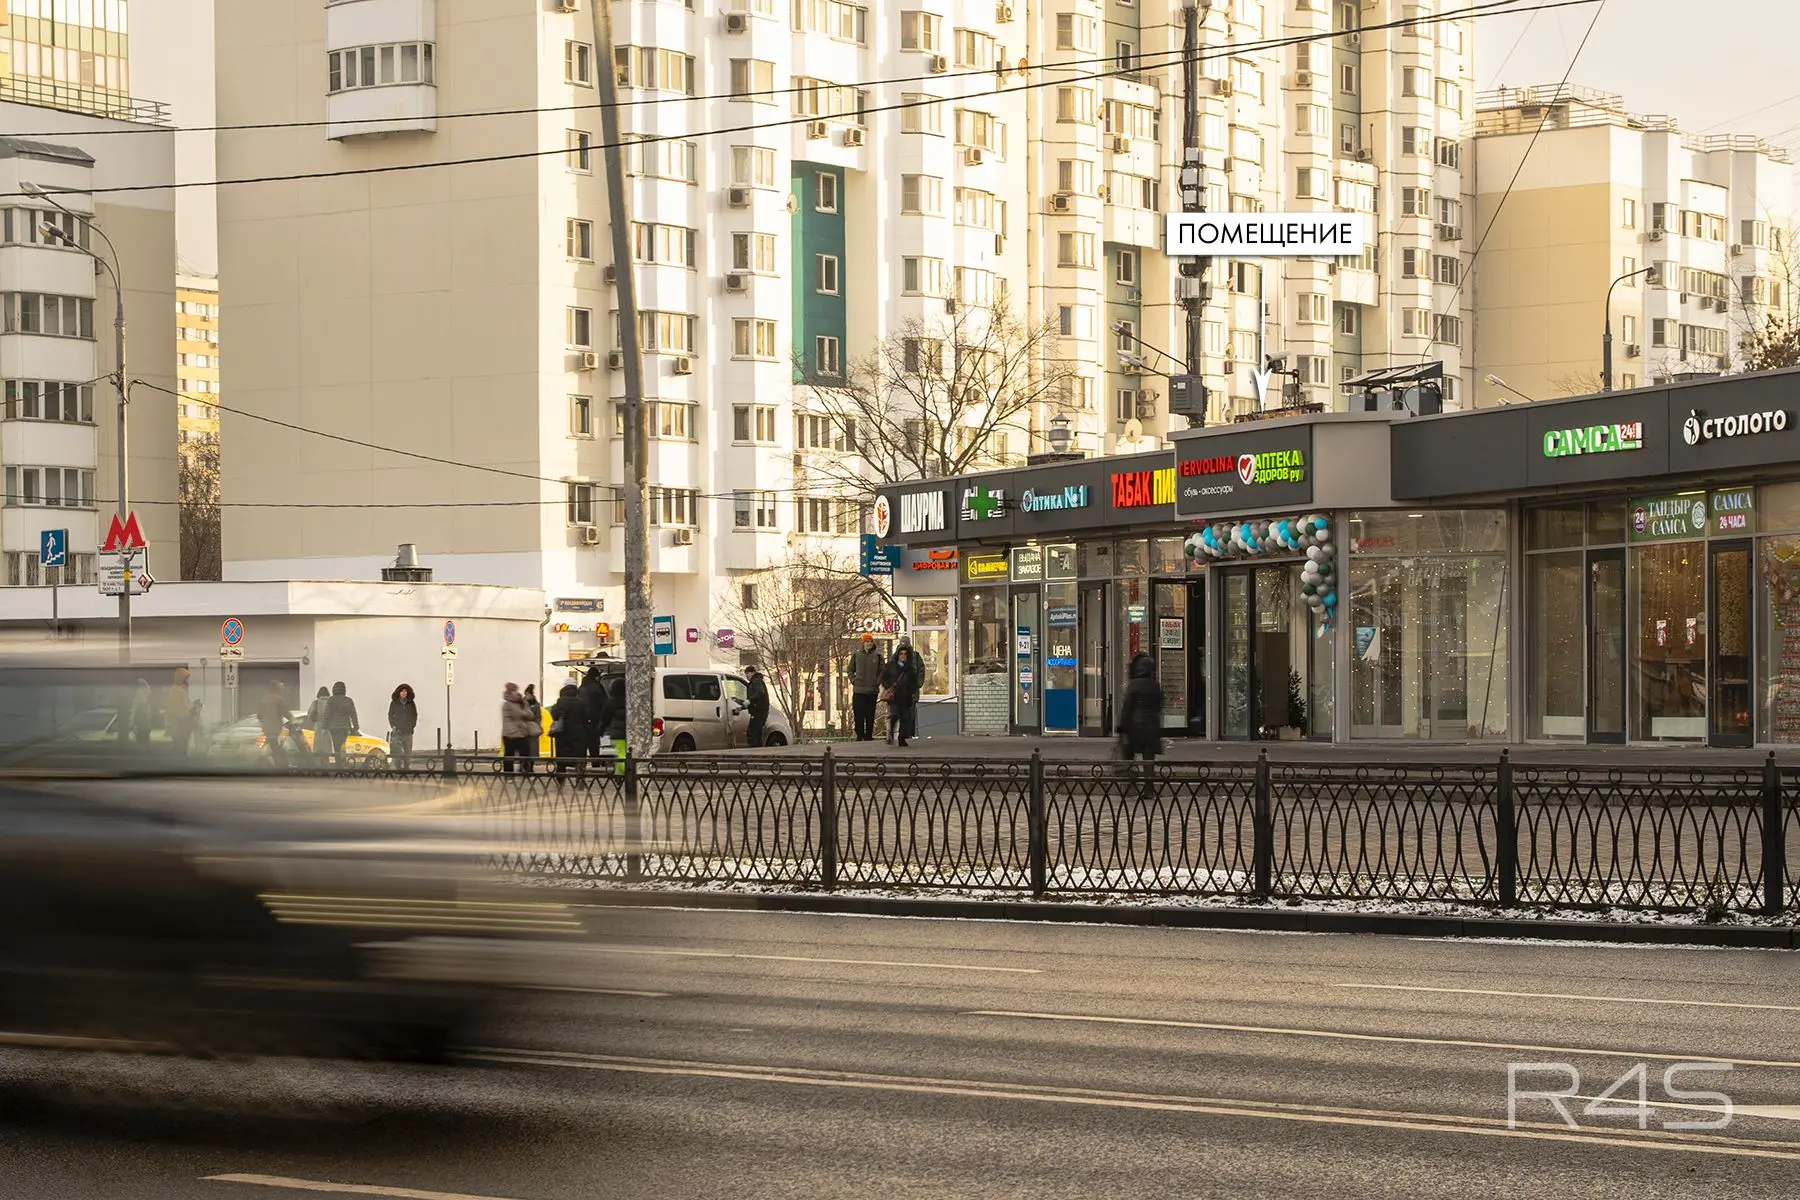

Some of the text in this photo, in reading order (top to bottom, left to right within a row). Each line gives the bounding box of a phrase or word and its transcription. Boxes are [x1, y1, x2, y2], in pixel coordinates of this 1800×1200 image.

[1703, 409, 1787, 439] СТОЛОТО
[1543, 424, 1621, 457] САМСА
[1178, 456, 1237, 476] TERVOLINA
[1255, 450, 1302, 469] АПТЕКА
[1254, 468, 1289, 483] ЗДОРОВ
[1111, 471, 1152, 507] ТАБАК
[1202, 484, 1234, 496] аксессуары
[1648, 499, 1691, 518] ТАНДЫР
[1714, 492, 1753, 511] САМСА
[901, 490, 945, 533] ШАУРМА
[1652, 519, 1687, 536] САМСА
[1719, 515, 1746, 529] 24 ЧАСА
[912, 561, 950, 570] ЦИФРОВАЯ
[1052, 645, 1072, 658] ЦЕНА
